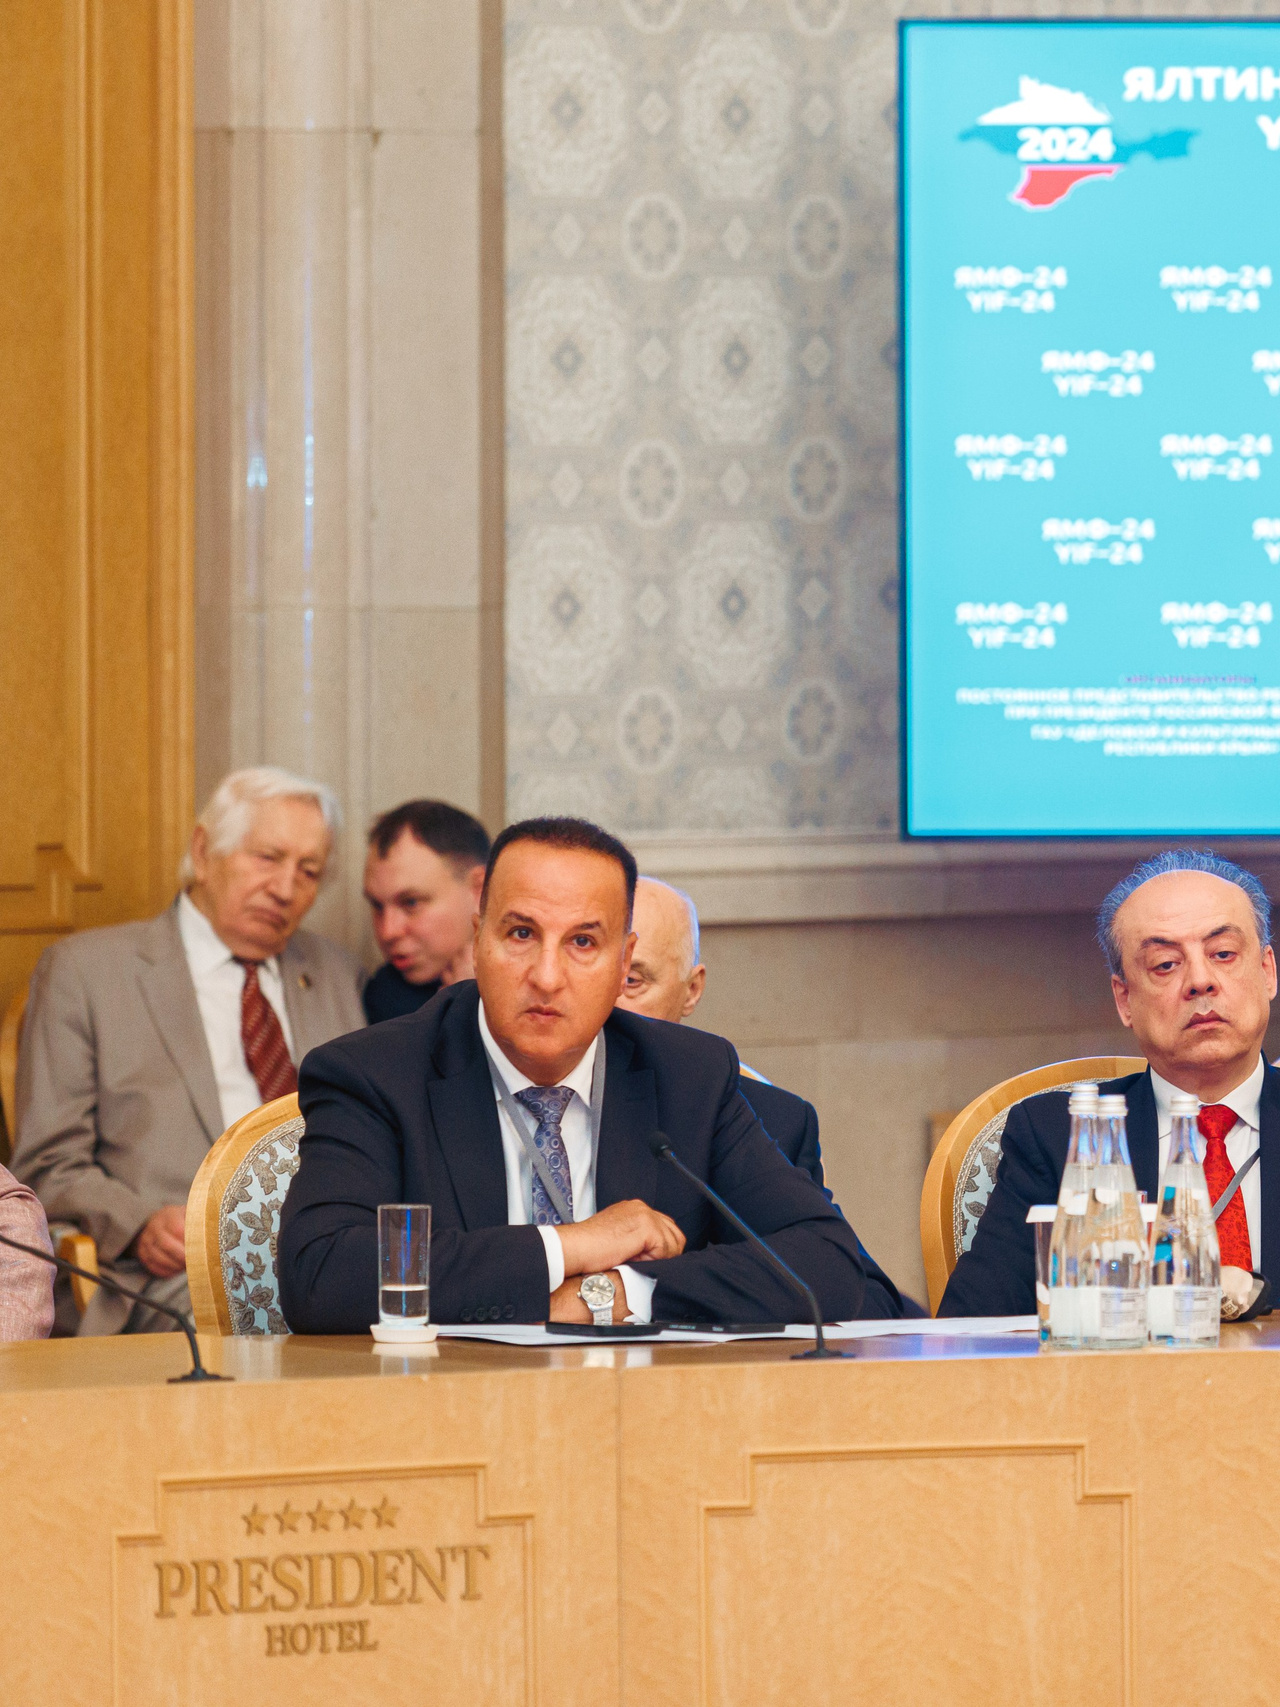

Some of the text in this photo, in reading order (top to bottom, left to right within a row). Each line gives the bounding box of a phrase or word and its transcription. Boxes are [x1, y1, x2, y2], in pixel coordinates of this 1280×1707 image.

[1017, 126, 1116, 162] 2024
[154, 1544, 490, 1619] PRESIDENT
[265, 1619, 378, 1657] HOTEL
